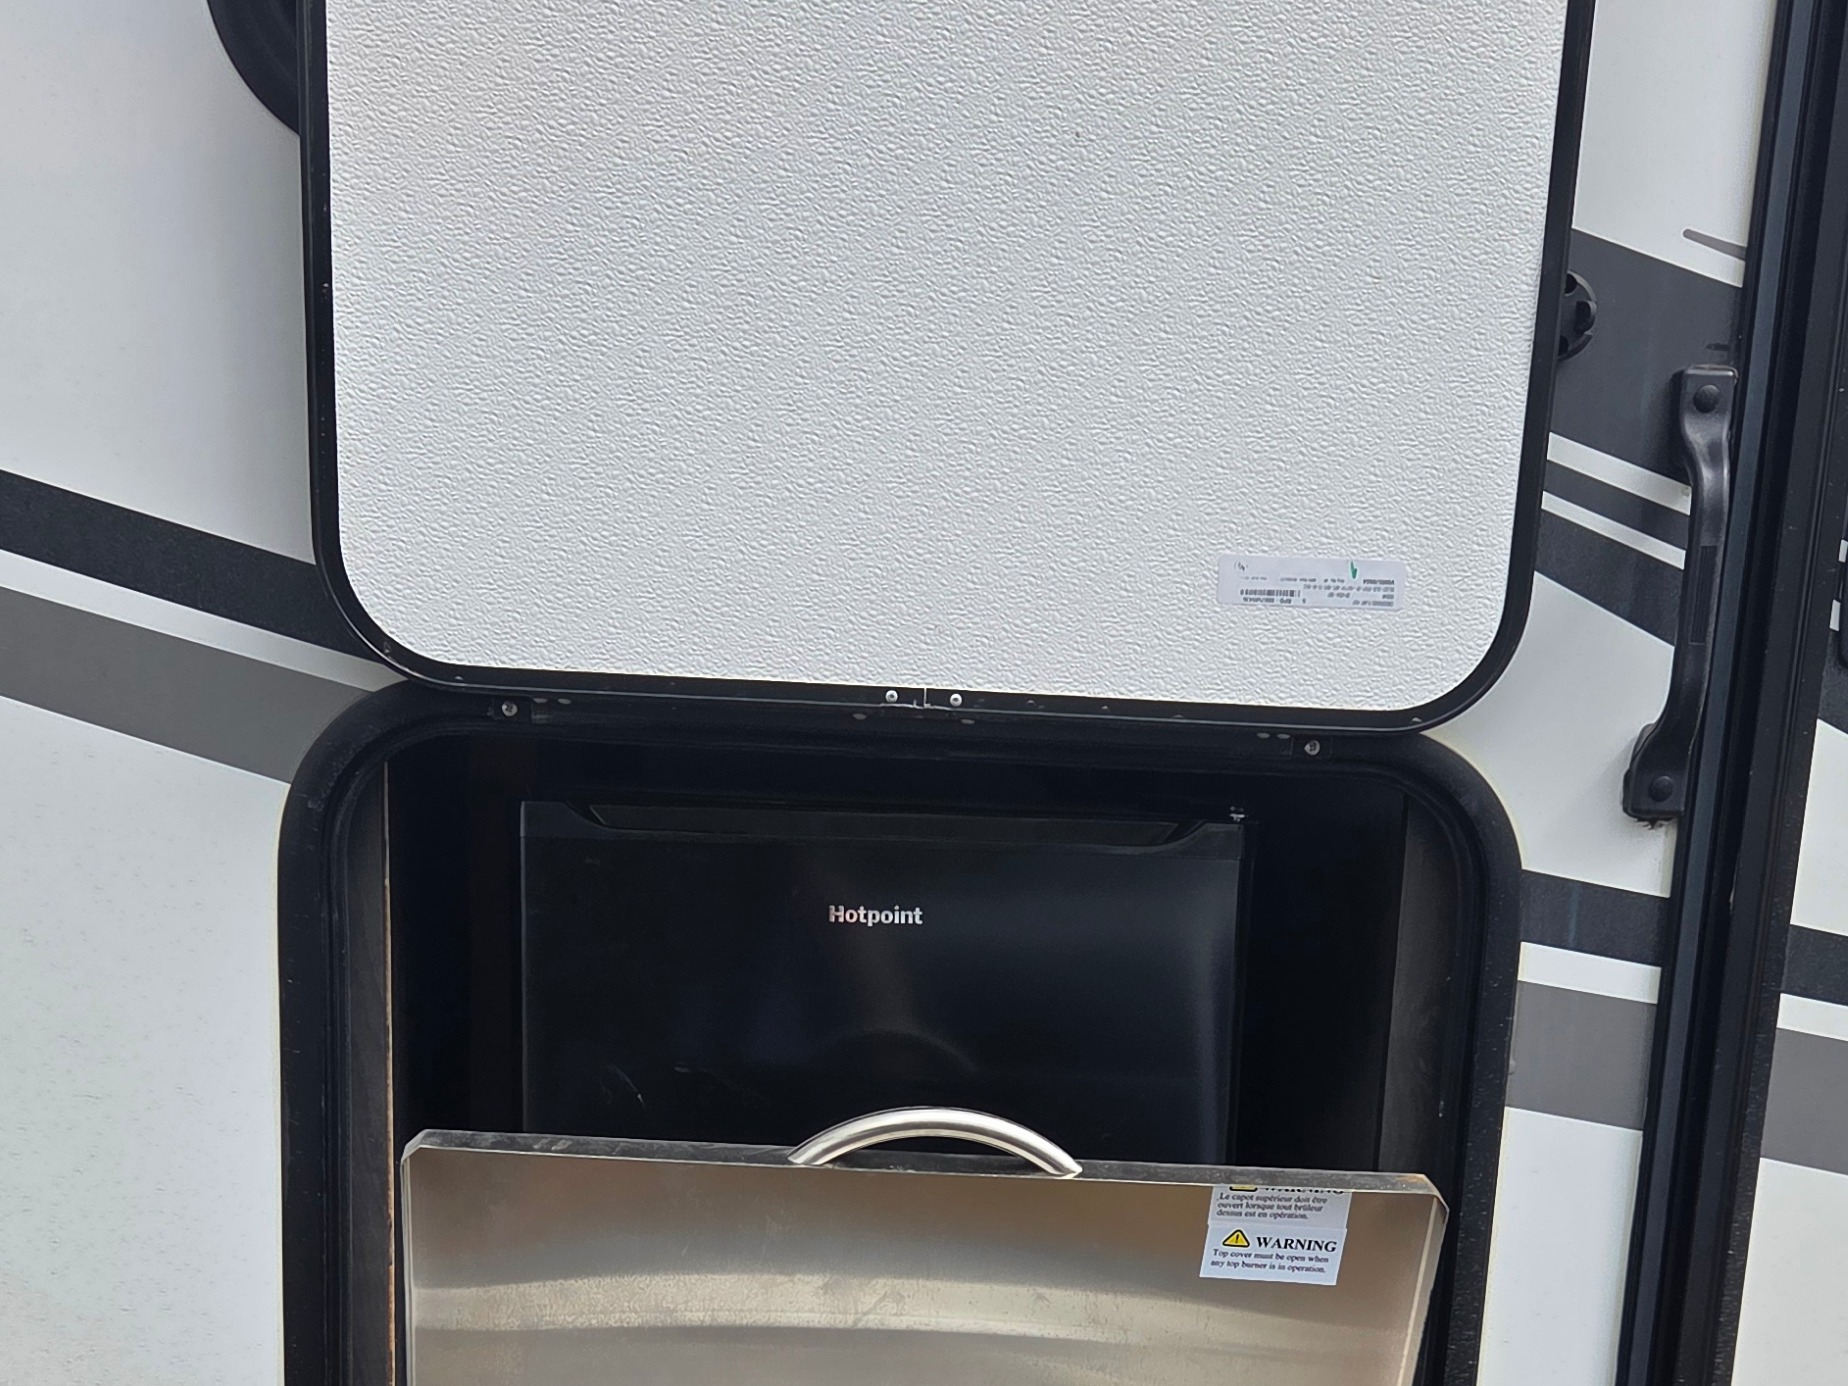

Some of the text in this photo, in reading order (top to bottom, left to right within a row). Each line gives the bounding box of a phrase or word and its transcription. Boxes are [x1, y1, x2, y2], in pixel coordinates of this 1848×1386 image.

[828, 905, 924, 927] Hotpoint
[1219, 1192, 1328, 1204] Le capot supérieur doit être
[1216, 1209, 1243, 1217] dessus
[1245, 1201, 1275, 1211] lorsque
[1293, 1203, 1323, 1212] brûleur
[1256, 1236, 1337, 1252] WARNING
[1212, 1248, 1228, 1258] Top
[1275, 1252, 1285, 1260] be
[1286, 1254, 1306, 1262] open
[1308, 1254, 1329, 1263] when
[1210, 1259, 1326, 1273] any top burner is in operation.
